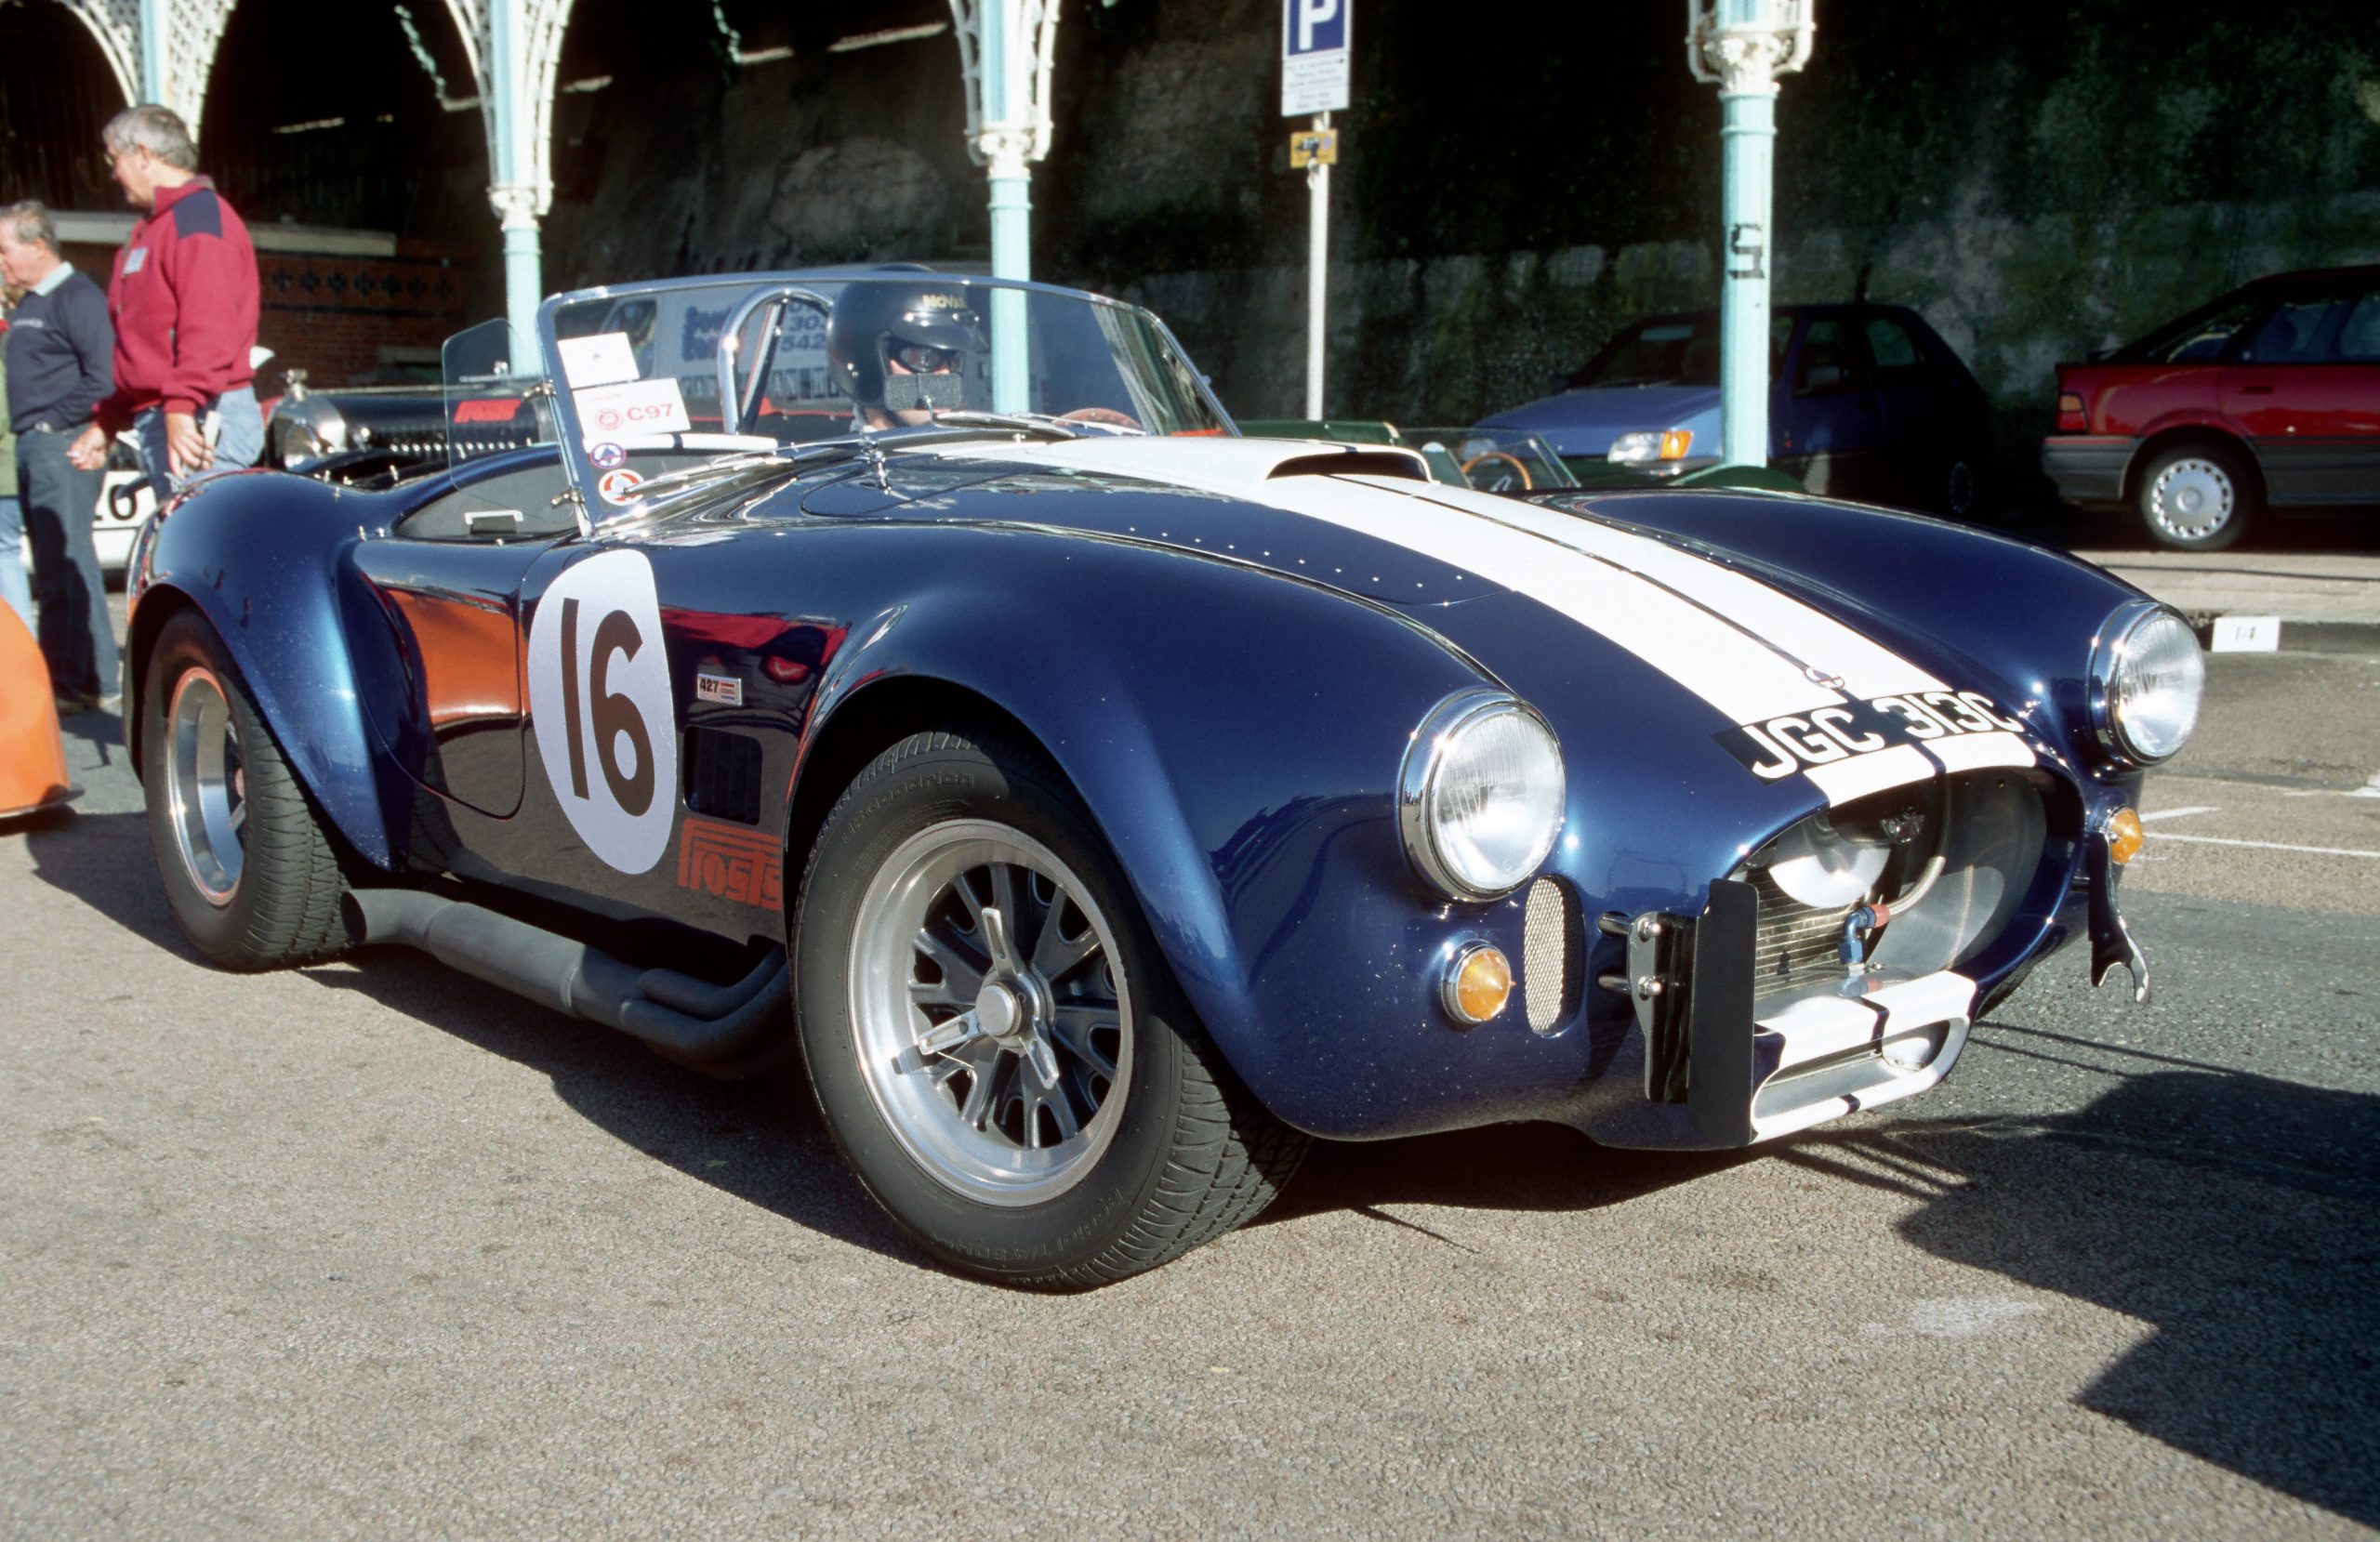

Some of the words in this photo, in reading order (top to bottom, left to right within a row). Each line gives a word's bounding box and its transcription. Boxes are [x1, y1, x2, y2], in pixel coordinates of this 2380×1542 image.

[1298, 0, 1338, 51] P
[627, 403, 673, 421] C97
[561, 598, 655, 817] 16
[699, 678, 720, 693] 427
[1742, 707, 1885, 780] JGC
[1871, 691, 2025, 740] 313C
